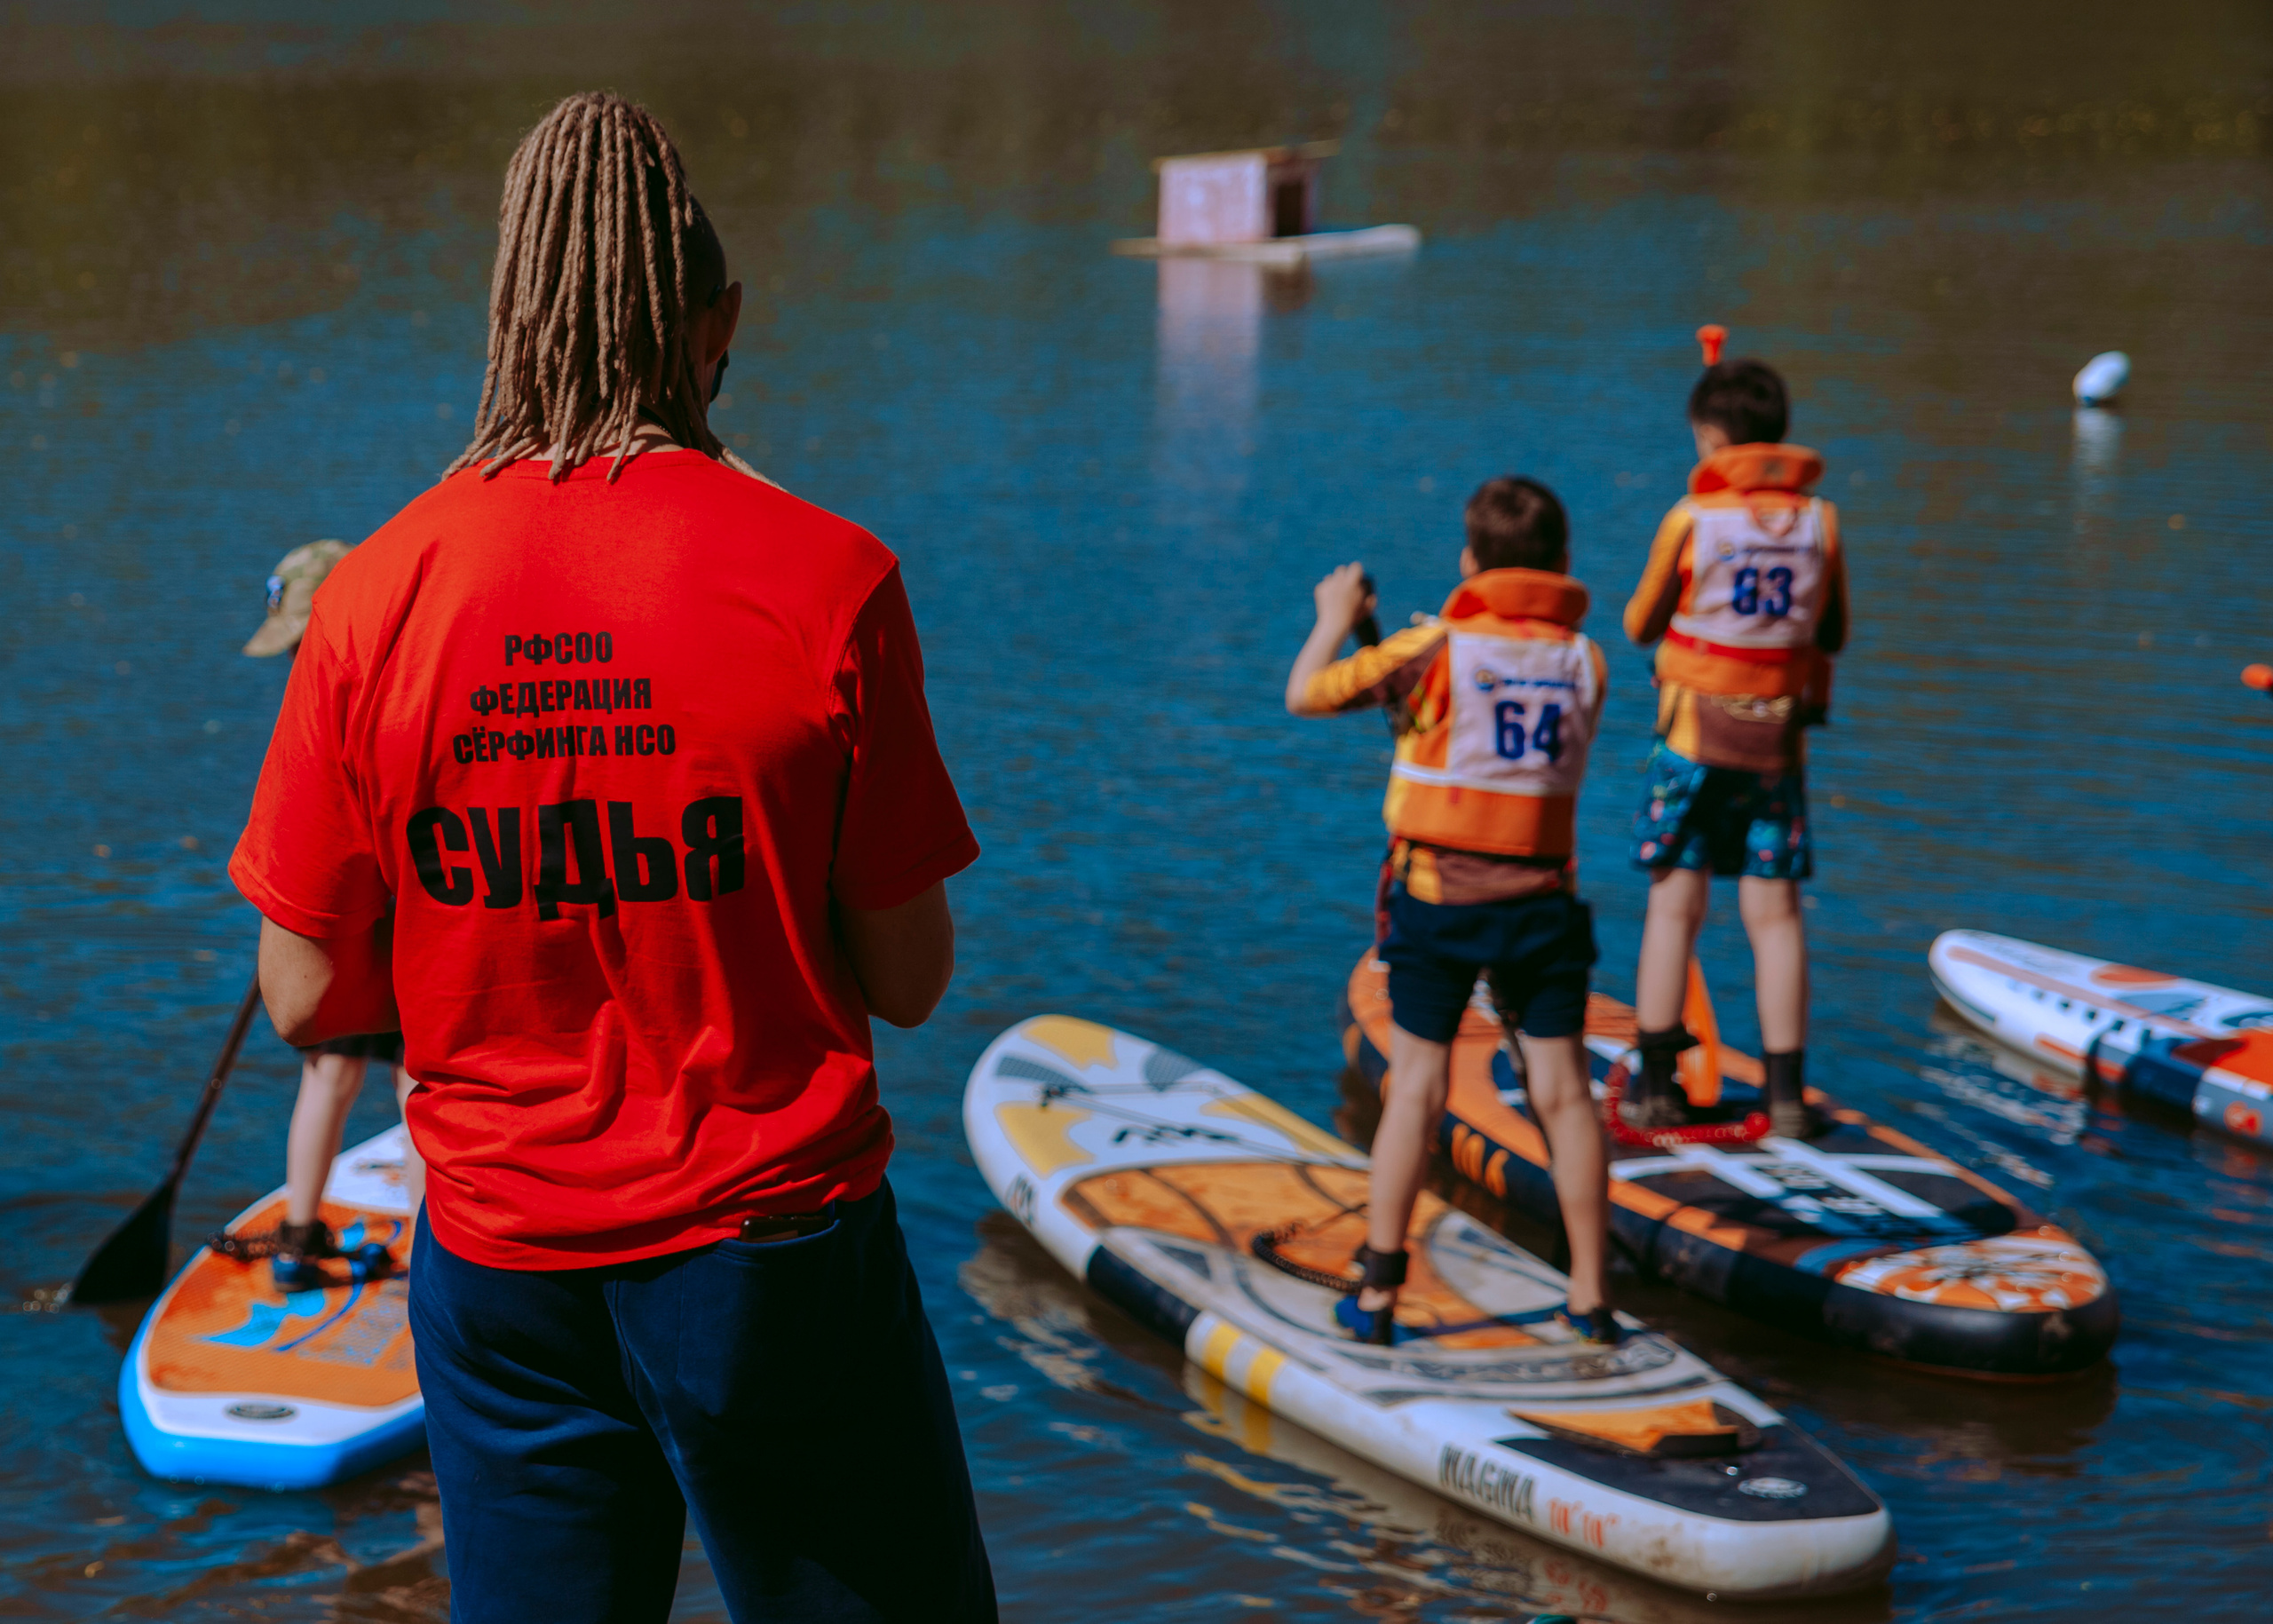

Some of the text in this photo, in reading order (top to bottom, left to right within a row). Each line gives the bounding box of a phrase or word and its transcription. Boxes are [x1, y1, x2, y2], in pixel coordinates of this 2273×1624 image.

[504, 631, 613, 666] РФСОО
[470, 678, 652, 718] ФЕДЕРАЦИЯ
[453, 725, 676, 764] СЁРФИНГА НСО
[1495, 701, 1561, 762] 64
[406, 796, 746, 921] СУДЬЯ
